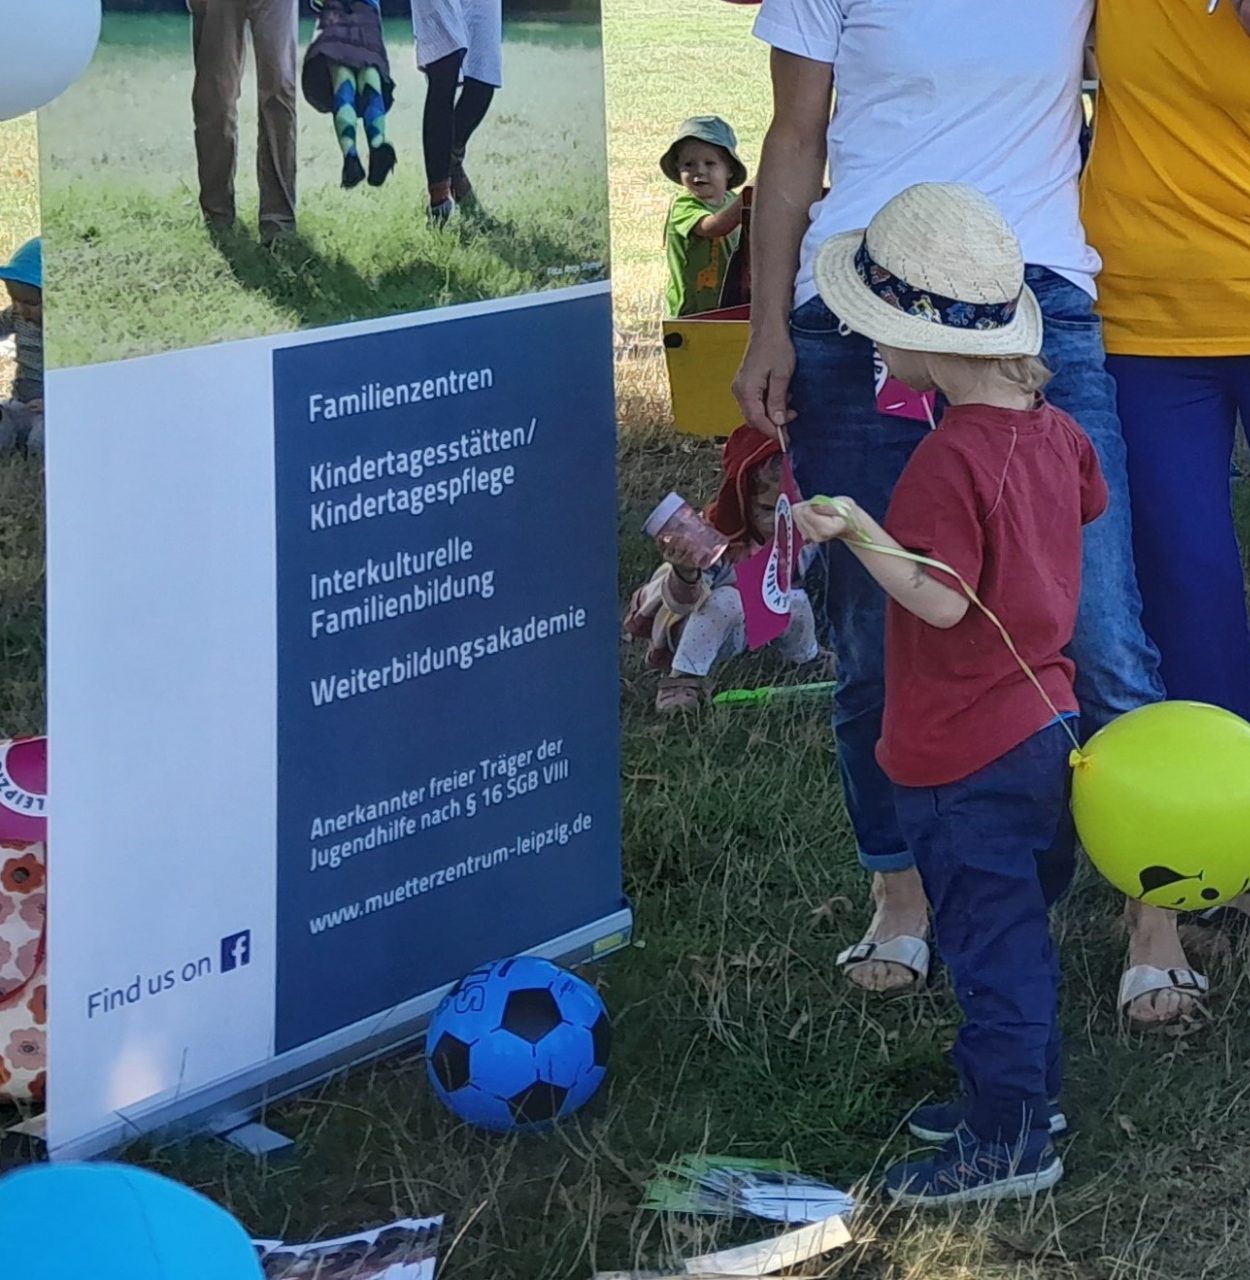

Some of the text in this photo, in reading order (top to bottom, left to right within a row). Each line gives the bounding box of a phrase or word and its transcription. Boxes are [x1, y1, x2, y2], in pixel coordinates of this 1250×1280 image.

[309, 367, 493, 422] Familienzentren
[310, 417, 537, 492] Kindertagesstätten/
[311, 464, 515, 531] Kindertagespflege
[311, 537, 473, 600] Interkulturelle
[312, 570, 495, 638] Familienbildung
[311, 606, 586, 706] Weiterbildungsakademie
[310, 737, 563, 840] Anerkannter freier Träger der
[310, 759, 568, 871] Jugendhilfe nach § 16 SGB VIII
[309, 813, 592, 934] www.muetterzentrum-leipzig.de
[87, 975, 140, 1019] Find
[149, 969, 175, 995] us
[182, 955, 211, 982] on
